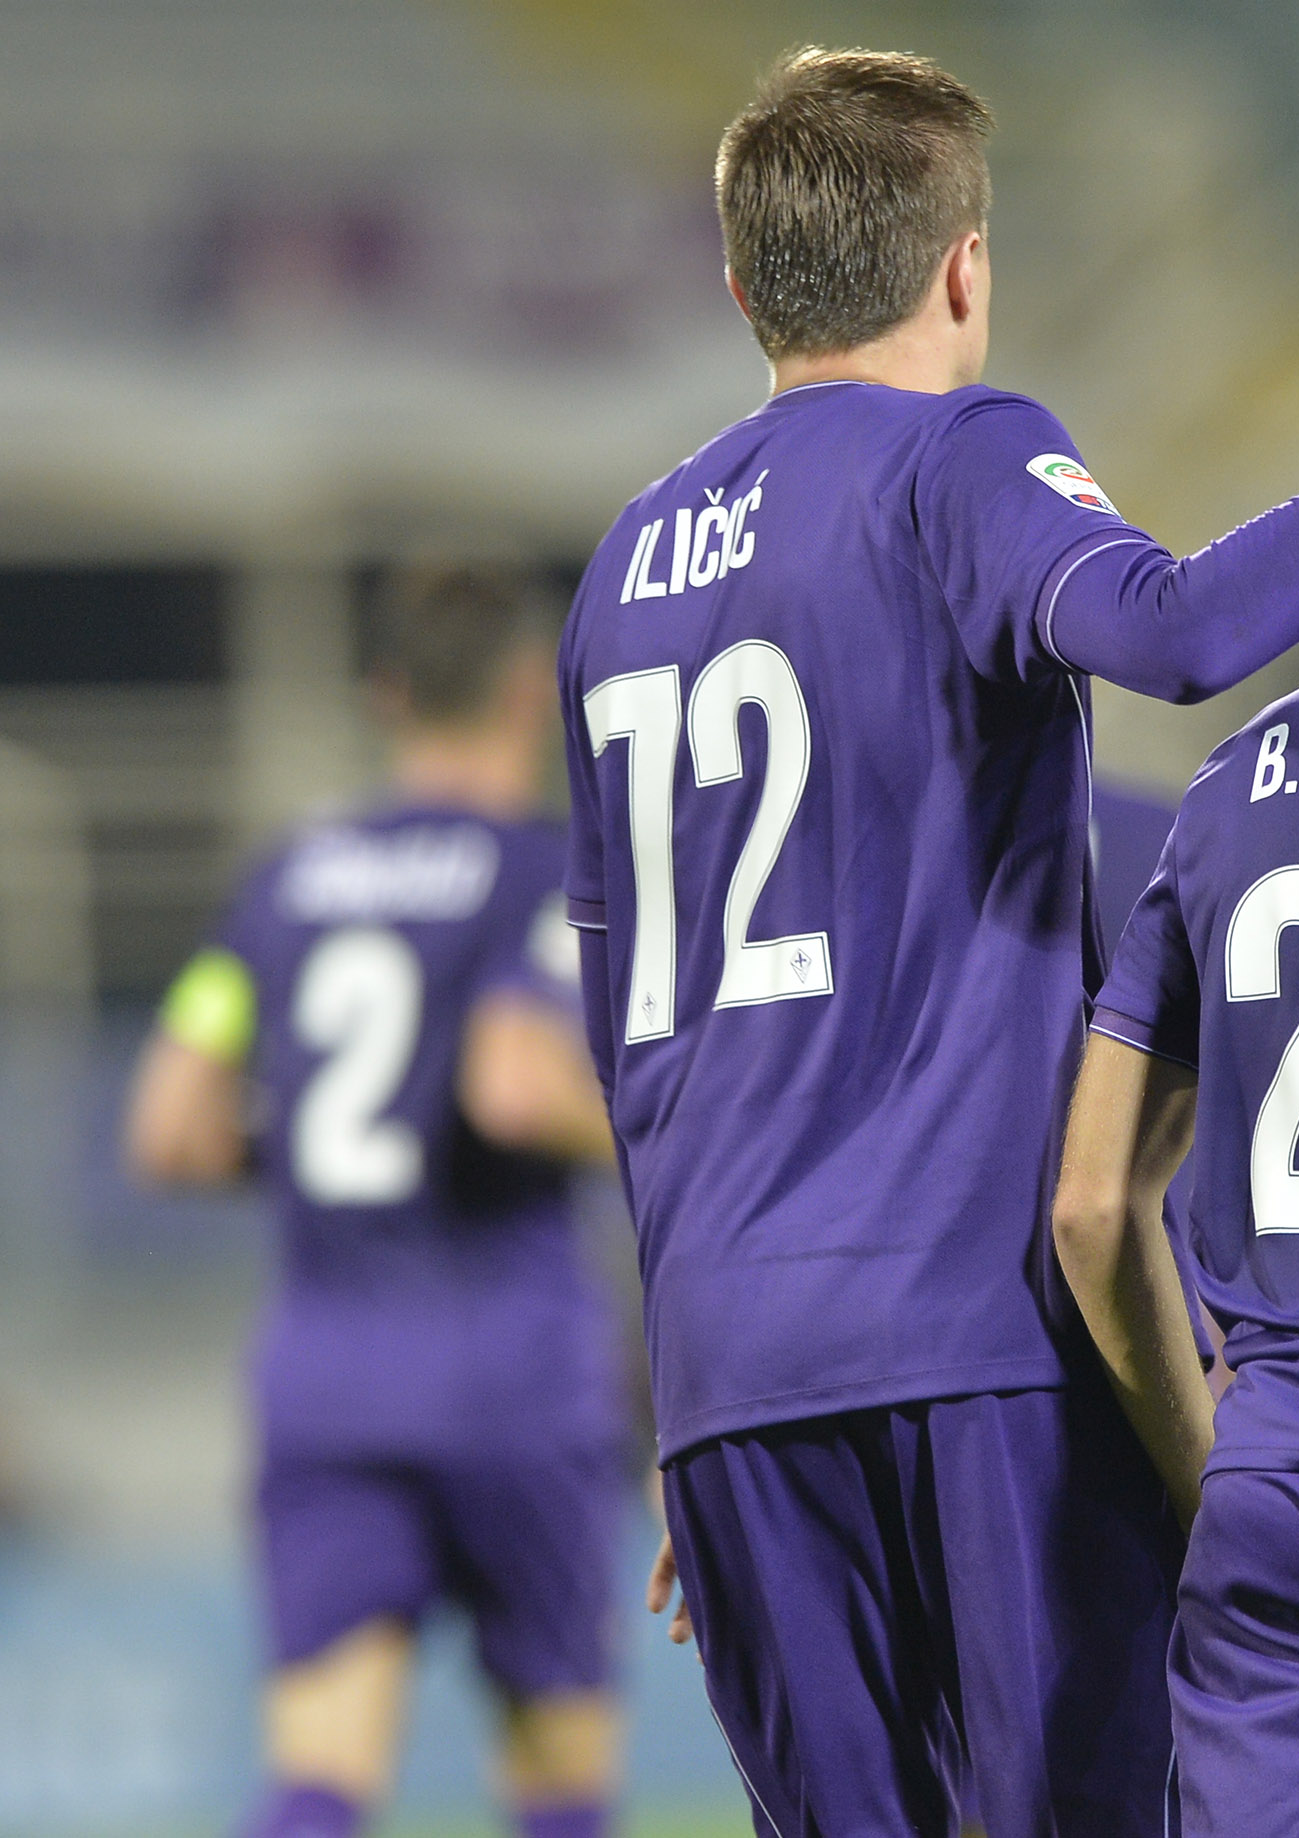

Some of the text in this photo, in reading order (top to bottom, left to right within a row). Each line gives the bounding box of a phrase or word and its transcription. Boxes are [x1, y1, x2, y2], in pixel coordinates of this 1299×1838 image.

[620, 469, 770, 604] ILIČIĆ
[583, 638, 834, 1045] 72
[1250, 722, 1298, 803] B.
[292, 924, 428, 1208] 2
